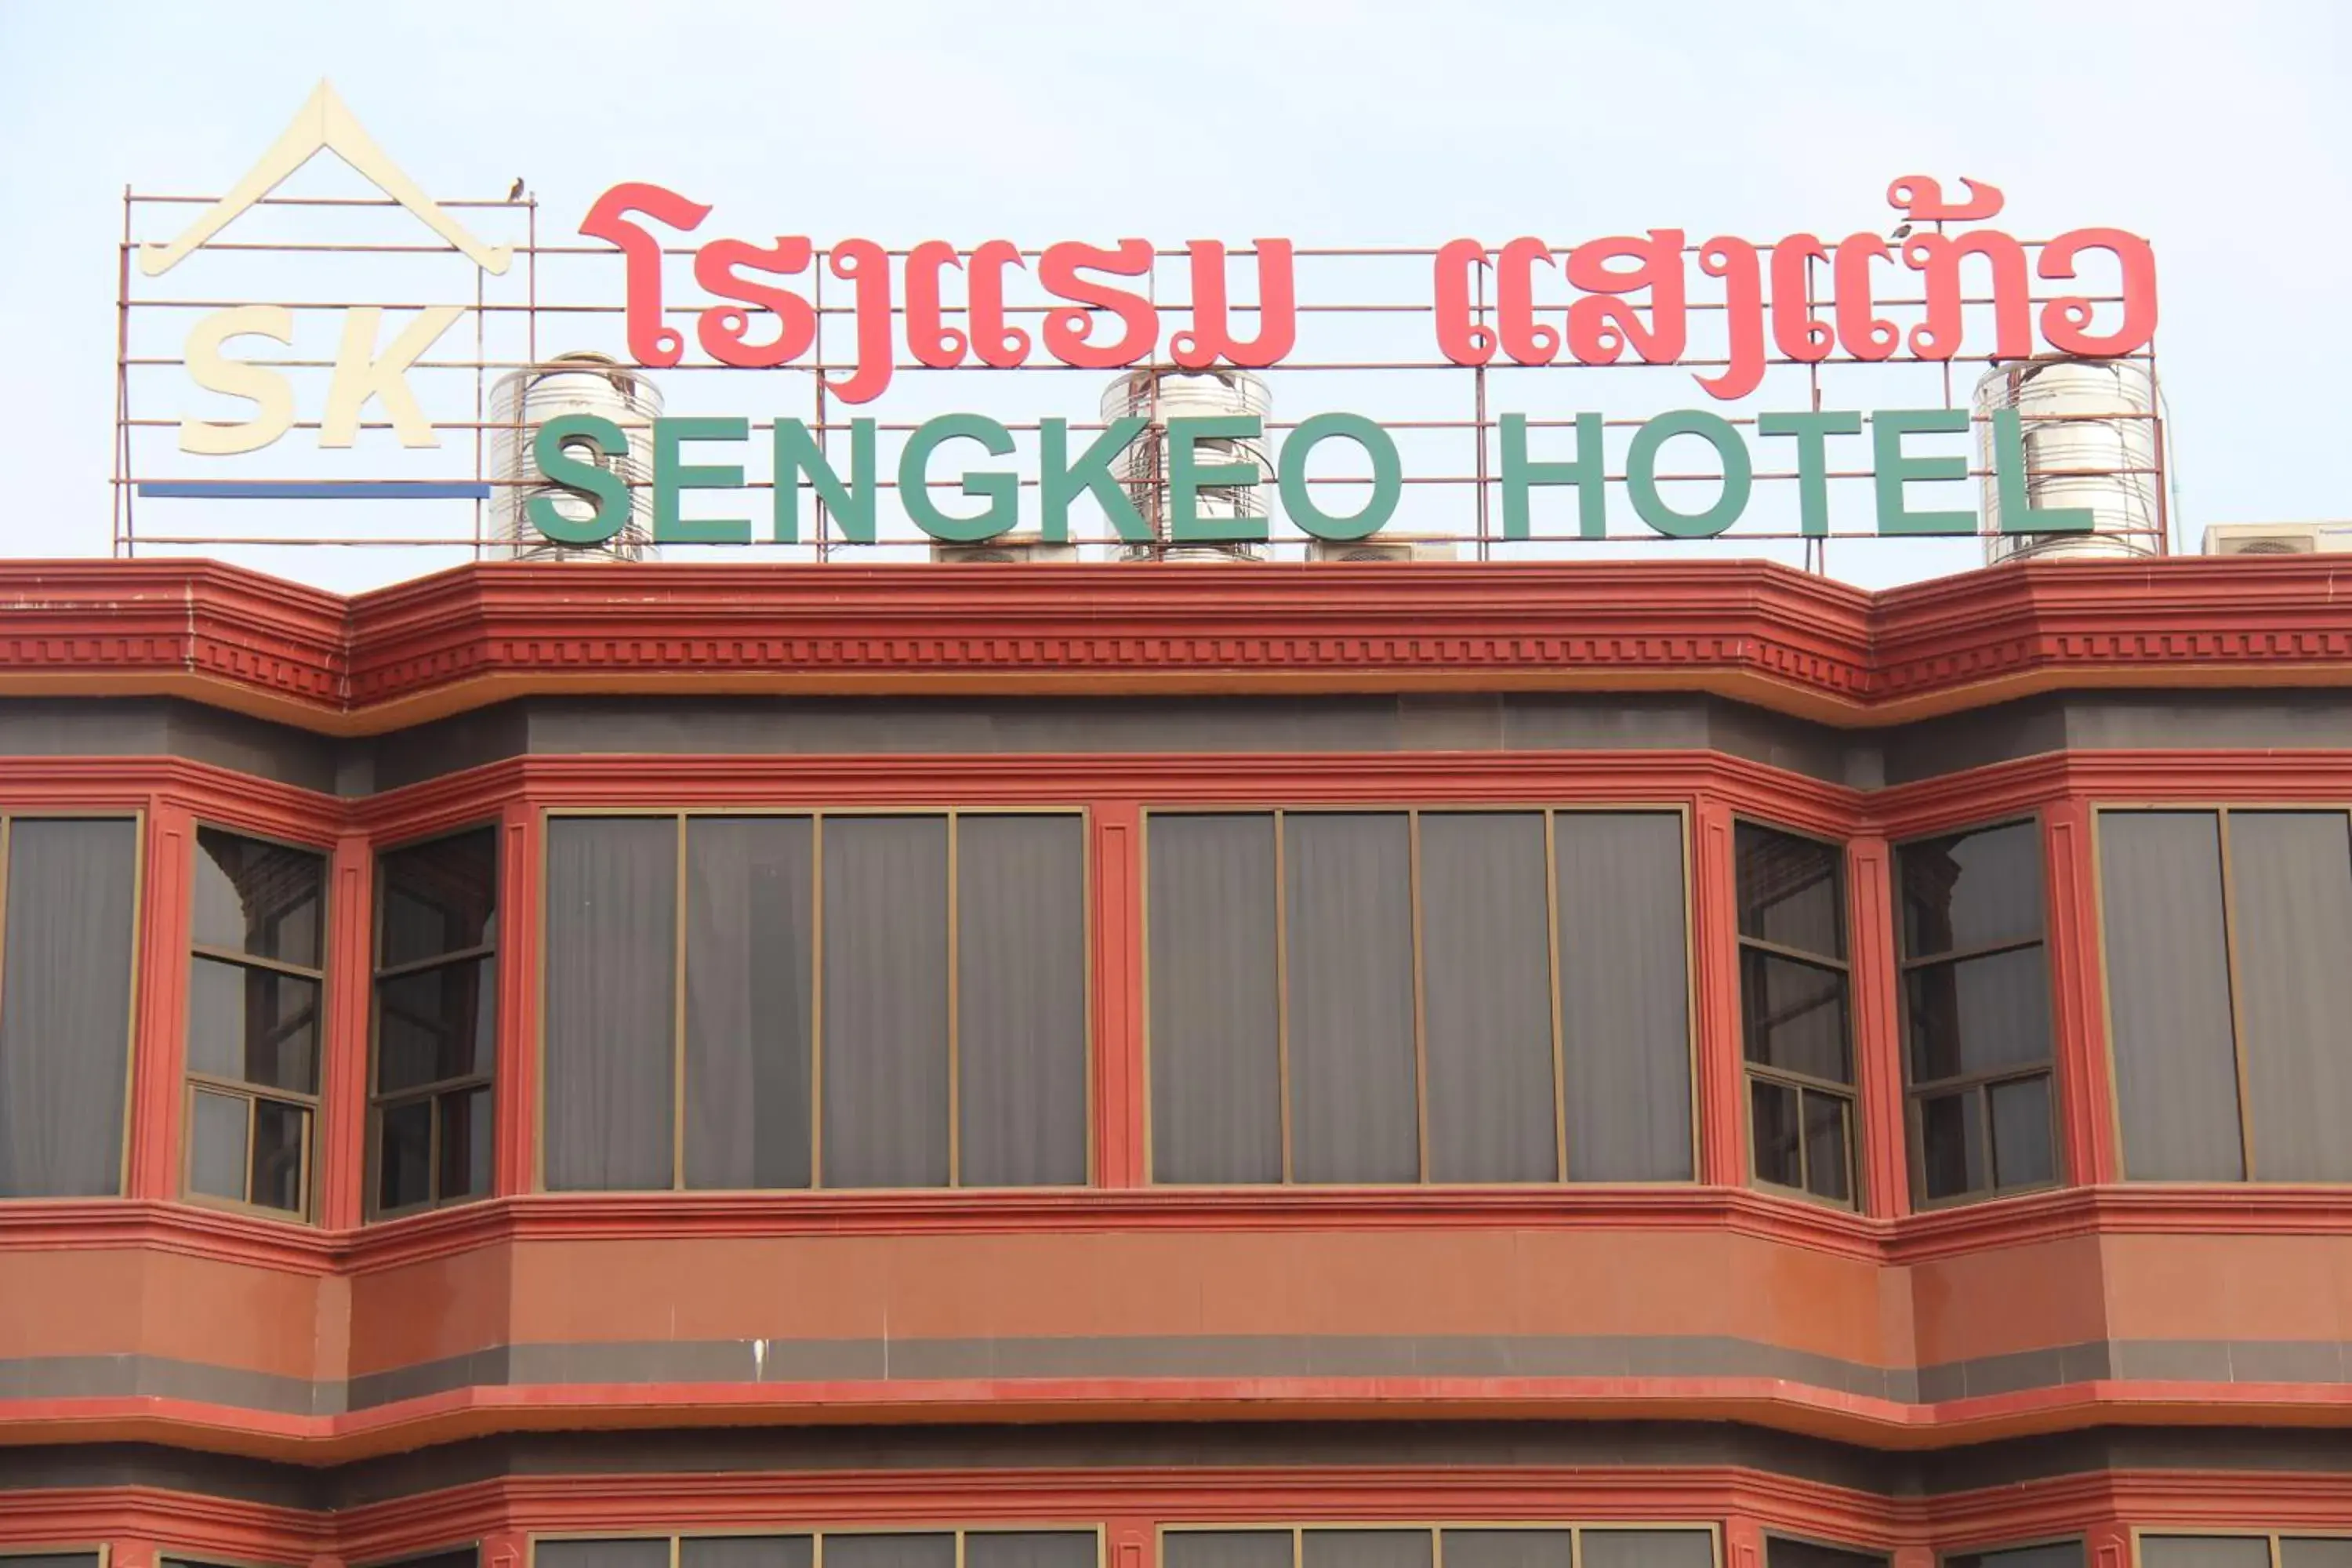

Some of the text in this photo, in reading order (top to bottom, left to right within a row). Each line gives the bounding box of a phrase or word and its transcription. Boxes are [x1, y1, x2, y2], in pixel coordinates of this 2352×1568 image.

[579, 175, 2158, 405] ໂຮງແຮມ ແສງແກ້ວ
[178, 304, 466, 456] SK
[525, 408, 2095, 545] SENGKEO HOTEL
